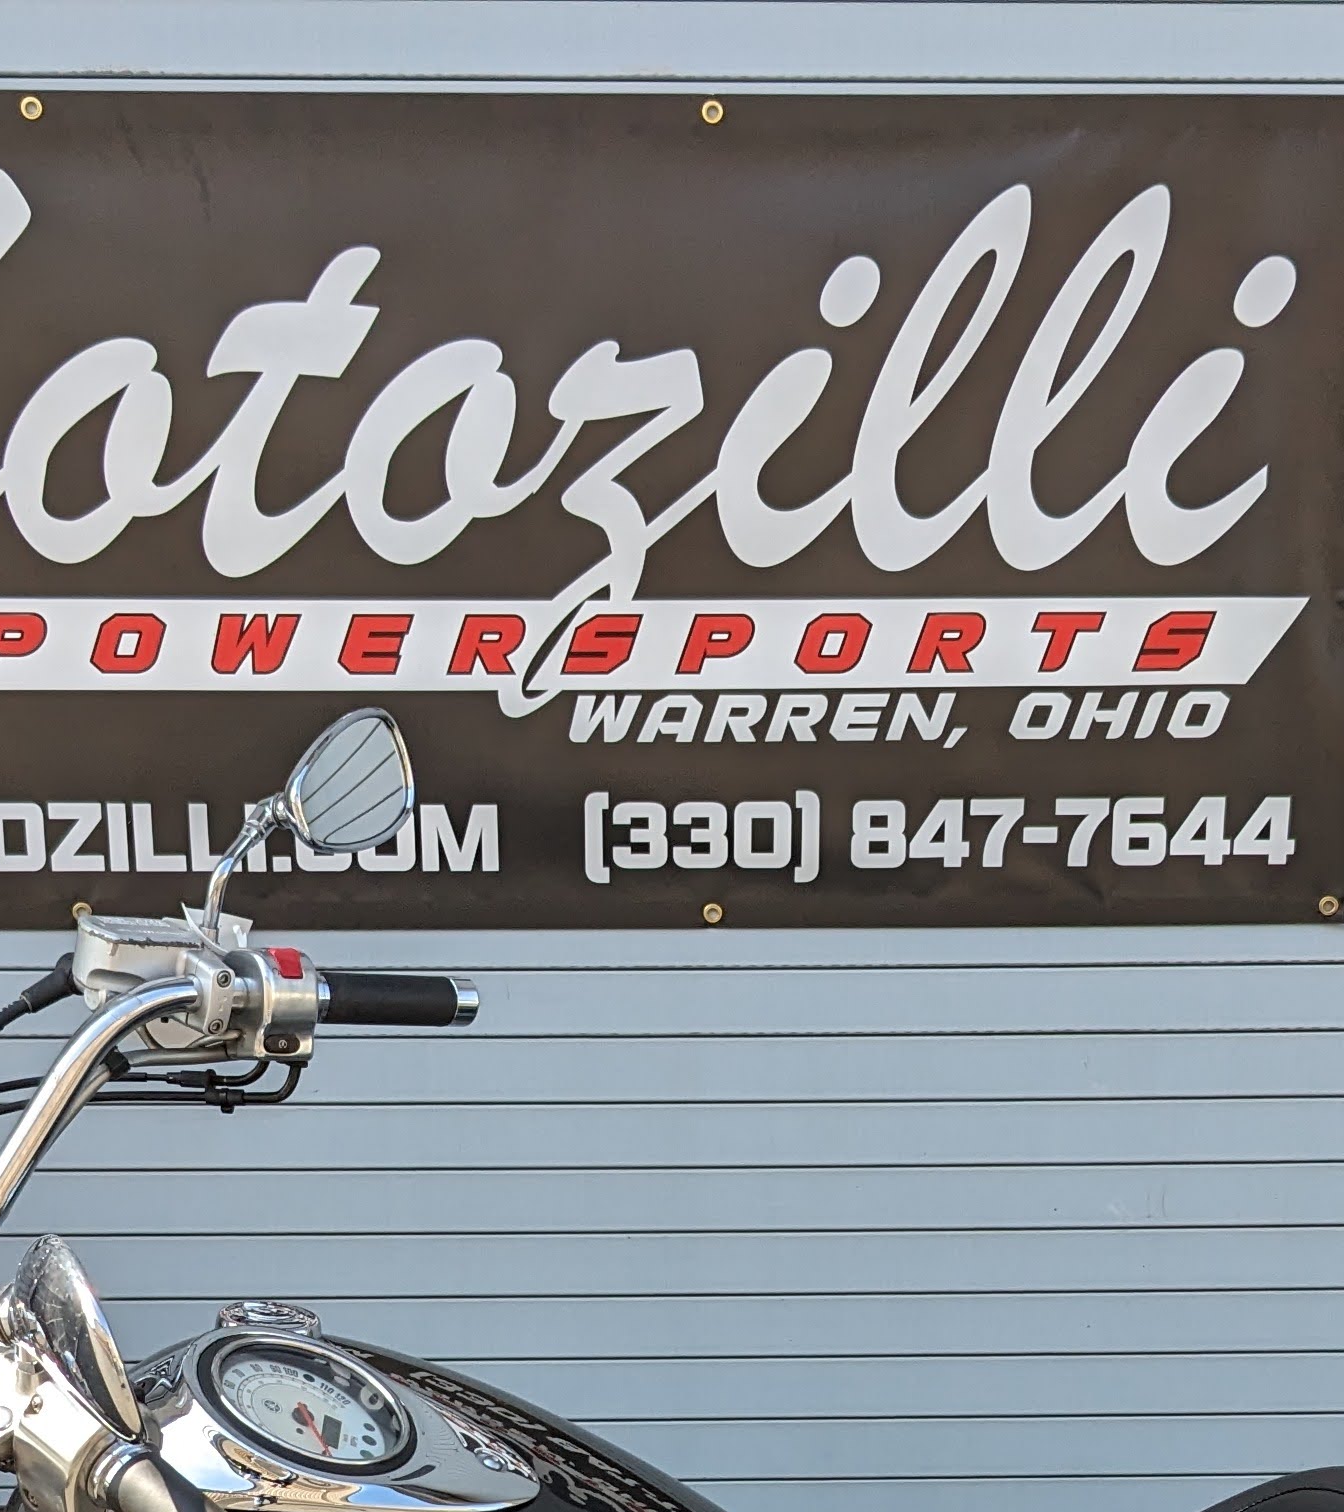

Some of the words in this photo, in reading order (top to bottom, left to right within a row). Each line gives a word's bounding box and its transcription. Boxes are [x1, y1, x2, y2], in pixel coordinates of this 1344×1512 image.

[567, 692, 968, 750] WARREN,
[1007, 690, 1231, 742] OHIO
[583, 790, 820, 884] (330)
[850, 796, 1296, 871] 847-7644
